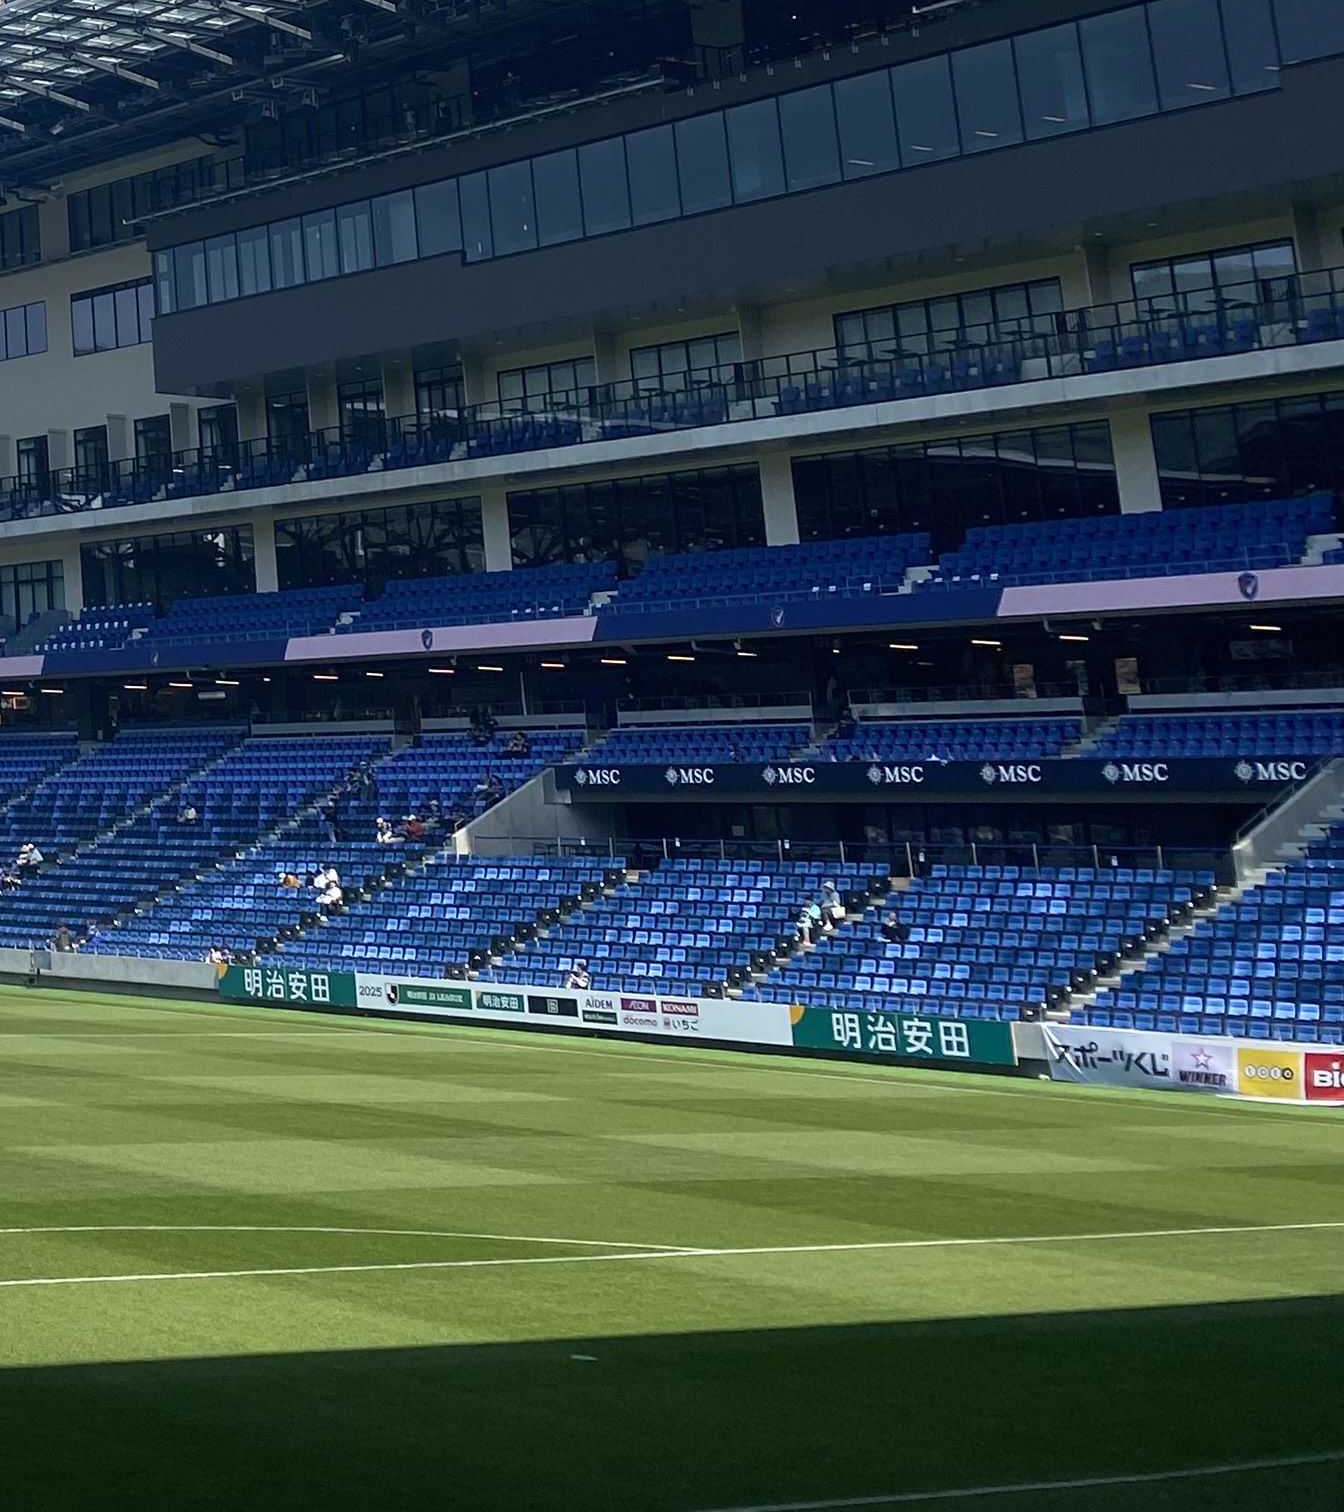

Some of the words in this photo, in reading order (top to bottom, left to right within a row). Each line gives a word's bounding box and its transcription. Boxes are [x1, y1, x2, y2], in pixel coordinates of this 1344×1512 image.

[587, 769, 621, 786] MSC
[679, 768, 715, 785] MSC
[777, 767, 816, 784] MSC
[882, 766, 925, 784] MSC
[998, 765, 1042, 783] MSC
[1121, 763, 1169, 782] MSC
[1256, 761, 1307, 781] MSC
[243, 968, 330, 1003] 明治安田
[358, 985, 383, 998] 2025
[436, 991, 464, 1003] LEAGUE
[482, 995, 519, 1010] 明治安田
[662, 1002, 697, 1015] KONAMI
[623, 1015, 658, 1027] docomo
[672, 1019, 699, 1031] いちご
[831, 1012, 971, 1058] 明治安田
[1053, 1040, 1170, 1078] スポーツくじ
[1178, 1070, 1227, 1087] WINNER
[1243, 1064, 1294, 1081] toto
[1313, 1060, 1344, 1088] Bi
